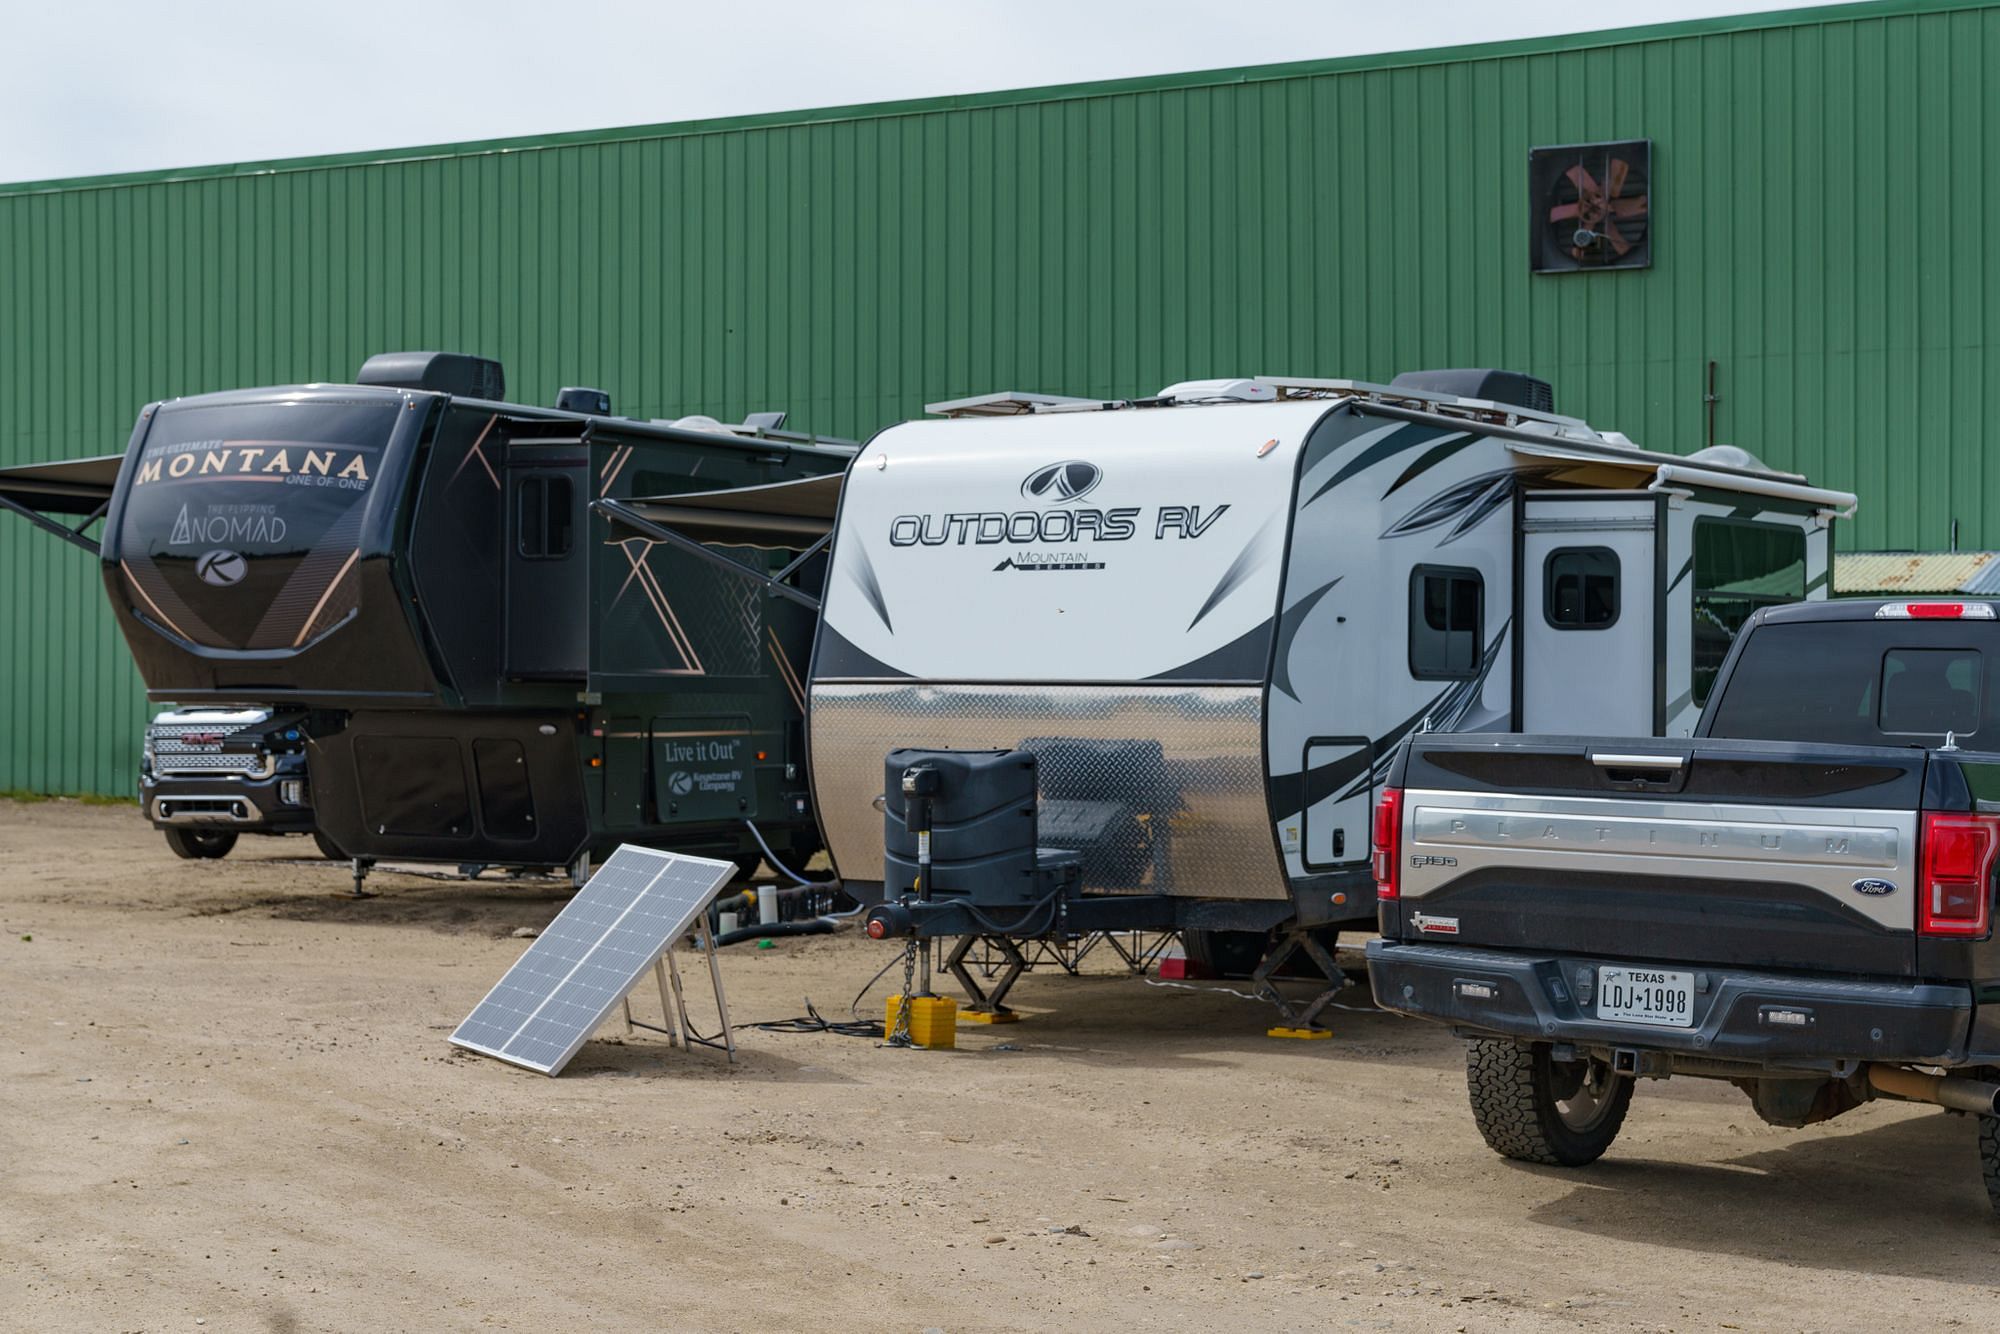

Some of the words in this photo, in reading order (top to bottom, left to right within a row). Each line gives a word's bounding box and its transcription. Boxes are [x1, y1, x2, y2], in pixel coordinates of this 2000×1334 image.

[136, 449, 369, 485] MONTANA
[286, 474, 312, 486] ONE
[316, 476, 334, 487] OF
[338, 478, 367, 491] ONE
[191, 516, 286, 543] NOMAD
[890, 507, 1142, 546] OUTDOORS
[1155, 504, 1231, 540] RV
[665, 742, 694, 762] Live
[696, 741, 707, 761] it
[1450, 819, 1849, 855] PLATINUM
[1628, 972, 1665, 984] TEXAS
